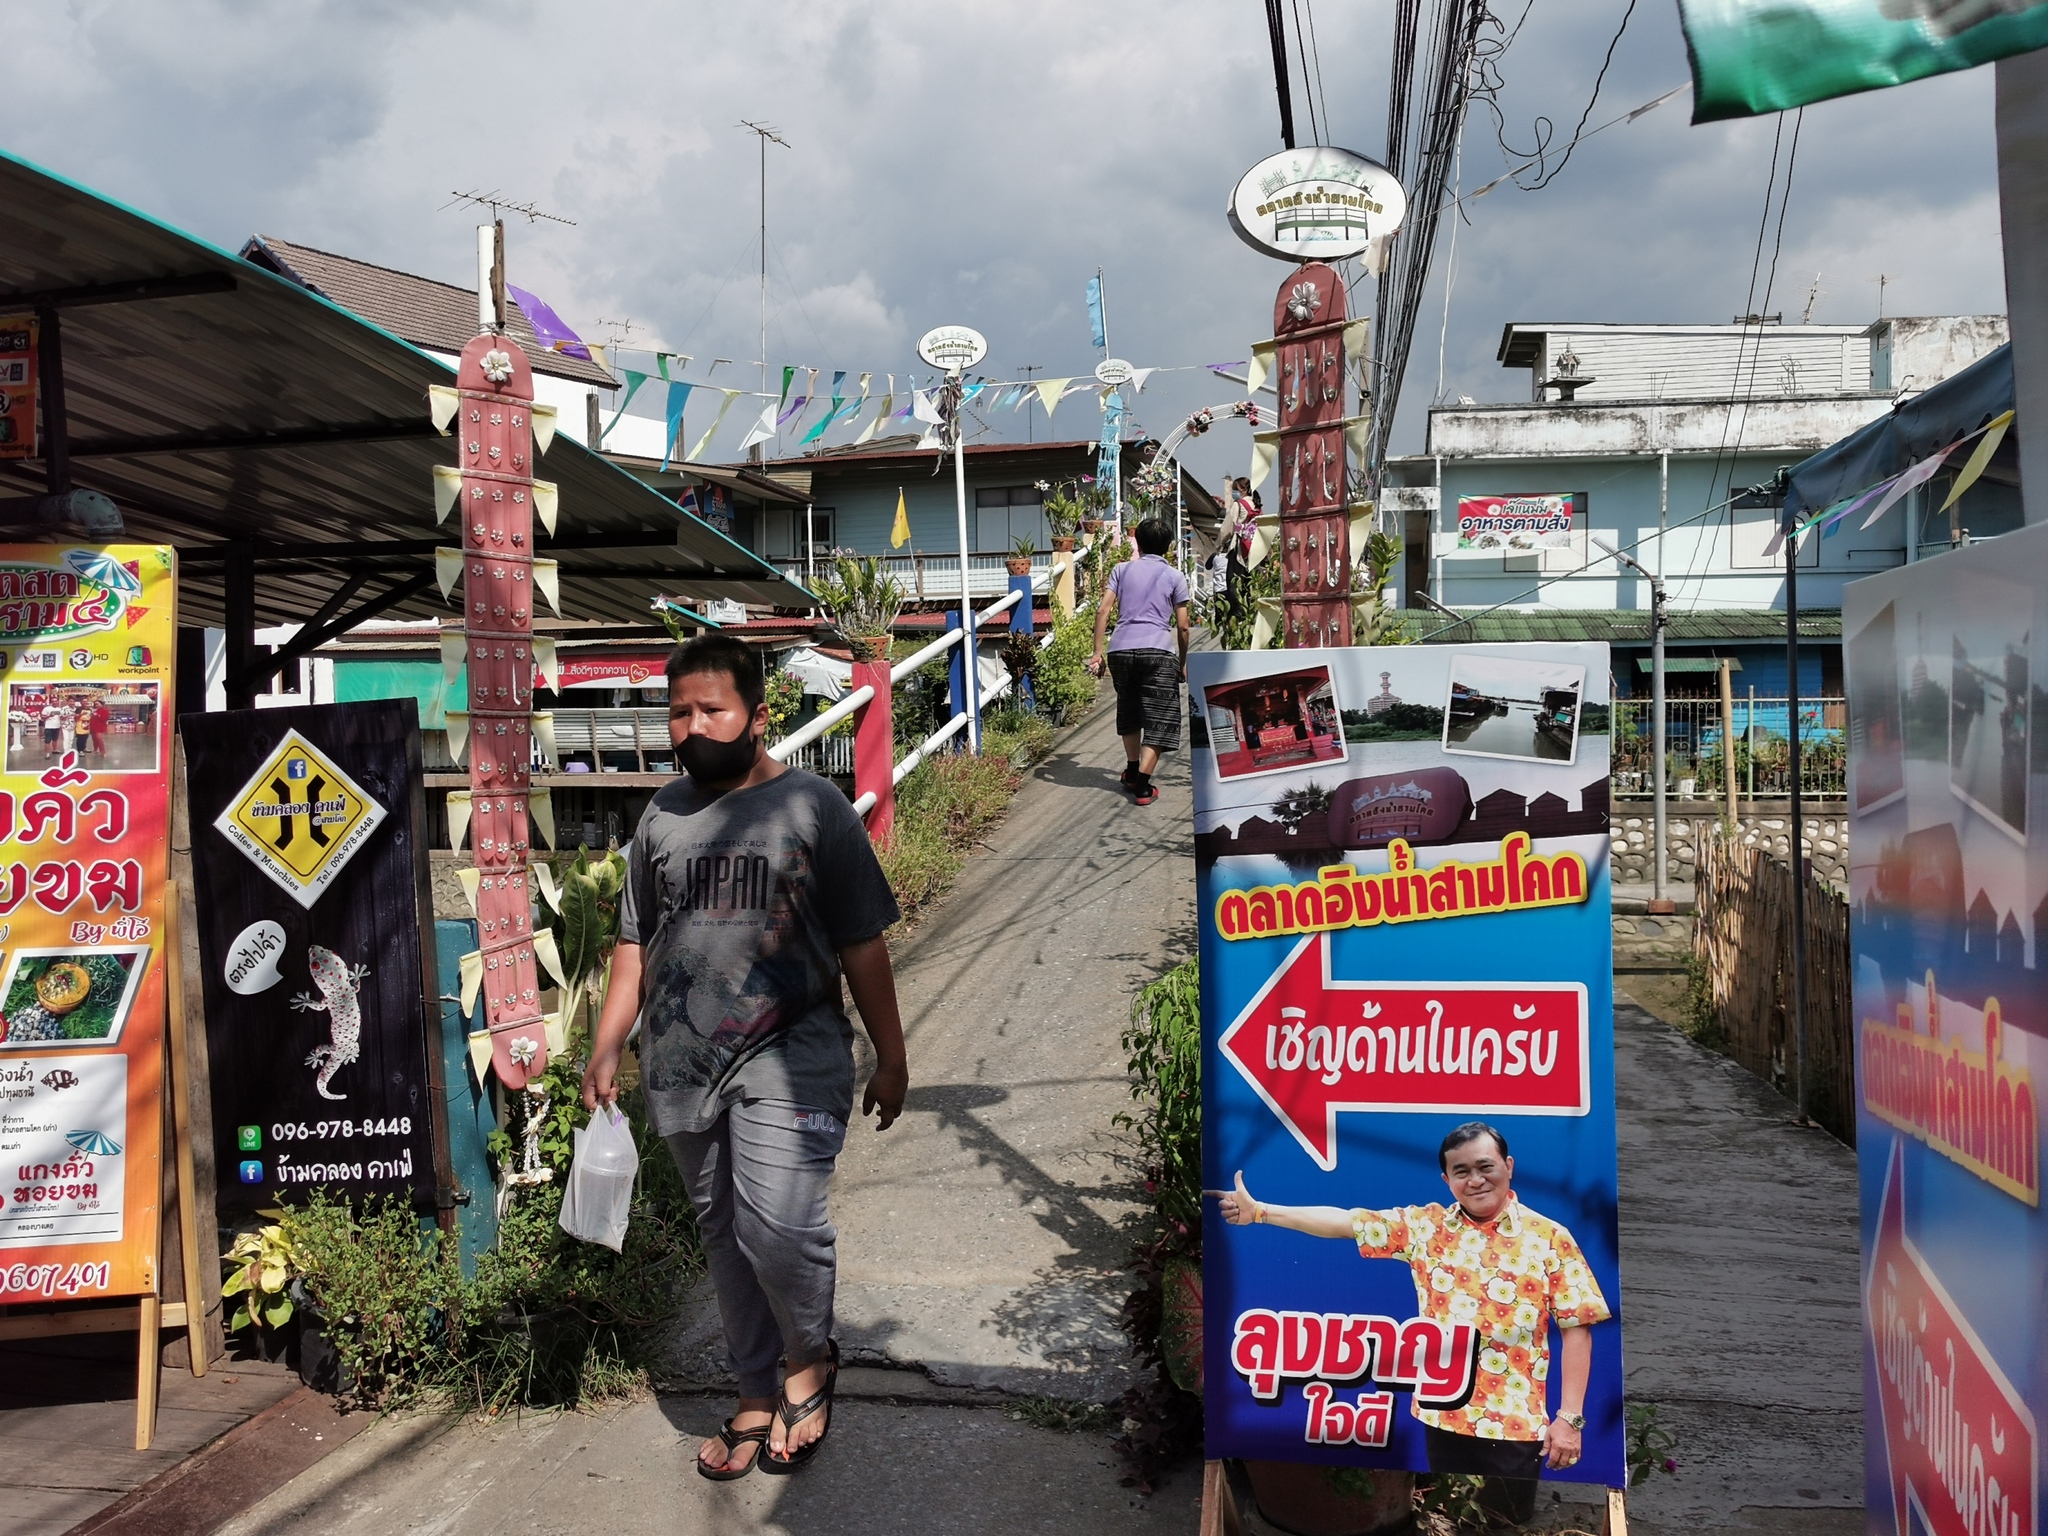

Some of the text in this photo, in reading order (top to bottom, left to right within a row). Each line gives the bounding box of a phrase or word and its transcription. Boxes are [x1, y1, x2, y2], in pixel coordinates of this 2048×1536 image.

[1461, 508, 1570, 530] อาหารตามสั่ง
[228, 824, 253, 851] Coffee
[261, 855, 299, 892] Munchies
[316, 817, 375, 886] Tel. 096-978-8448
[679, 856, 770, 911] JAPAN
[1220, 837, 1582, 935] ตลาดอิงน้ำสามโคก
[72, 921, 106, 943] By
[229, 929, 281, 984] ตรงไปจ้า
[1266, 1000, 1558, 1086] เชิญด้านในครับ
[272, 1117, 412, 1141] 096-978-8448
[13, 1182, 98, 1204] หอยขม
[18, 1151, 95, 1181] แกงคั่ว
[276, 1154, 362, 1182] ข้ามคลอง
[1236, 1313, 1471, 1396] ลุงชาญ
[1306, 1385, 1393, 1444] ใจดี
